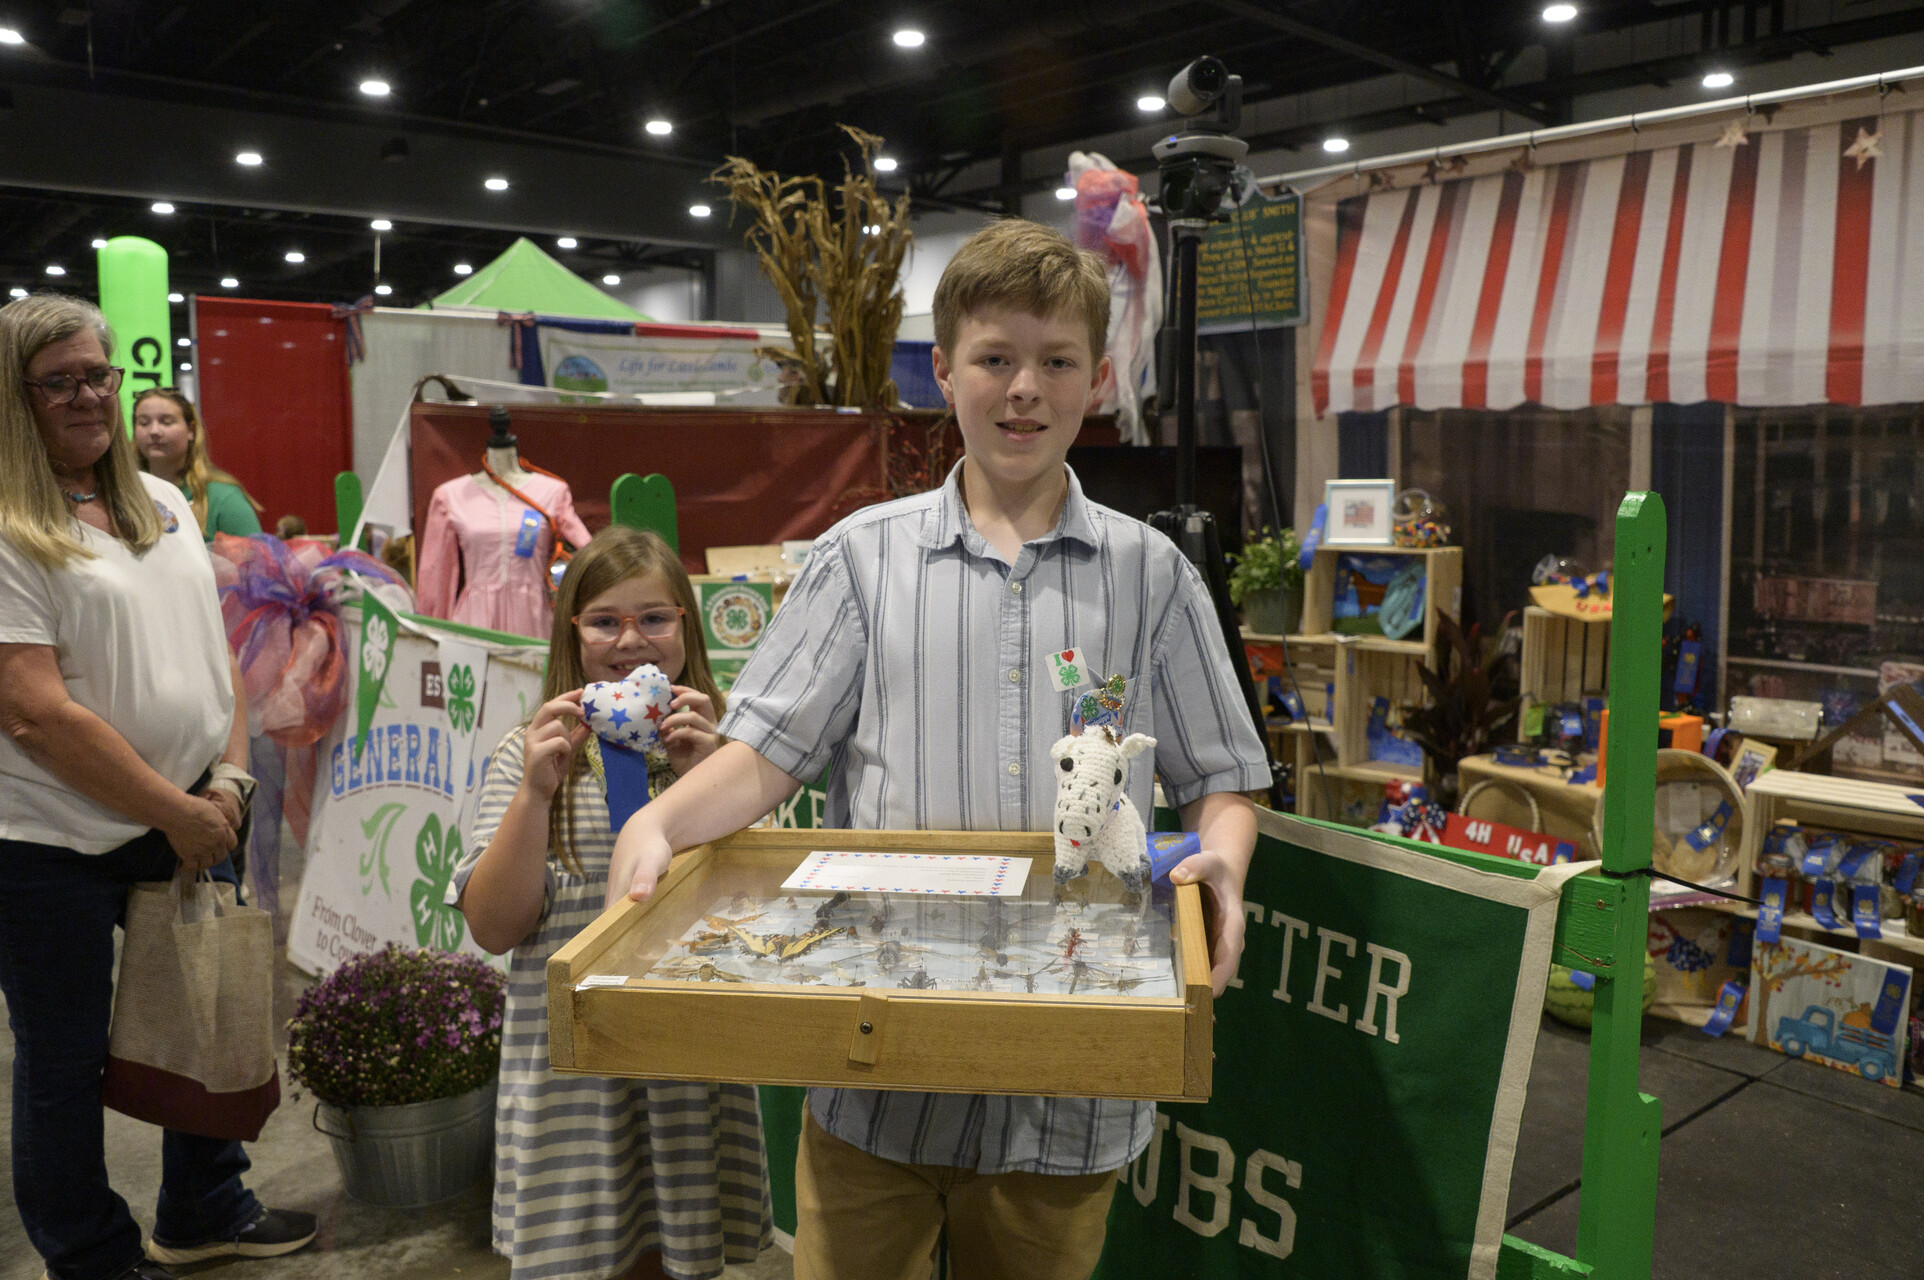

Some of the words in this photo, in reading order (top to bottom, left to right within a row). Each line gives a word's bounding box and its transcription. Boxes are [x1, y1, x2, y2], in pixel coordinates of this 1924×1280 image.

[1465, 820, 1493, 845] 4H
[311, 895, 341, 931] From
[343, 913, 377, 952] Clover
[316, 929, 329, 950] to
[1117, 1111, 1302, 1260] UBS
